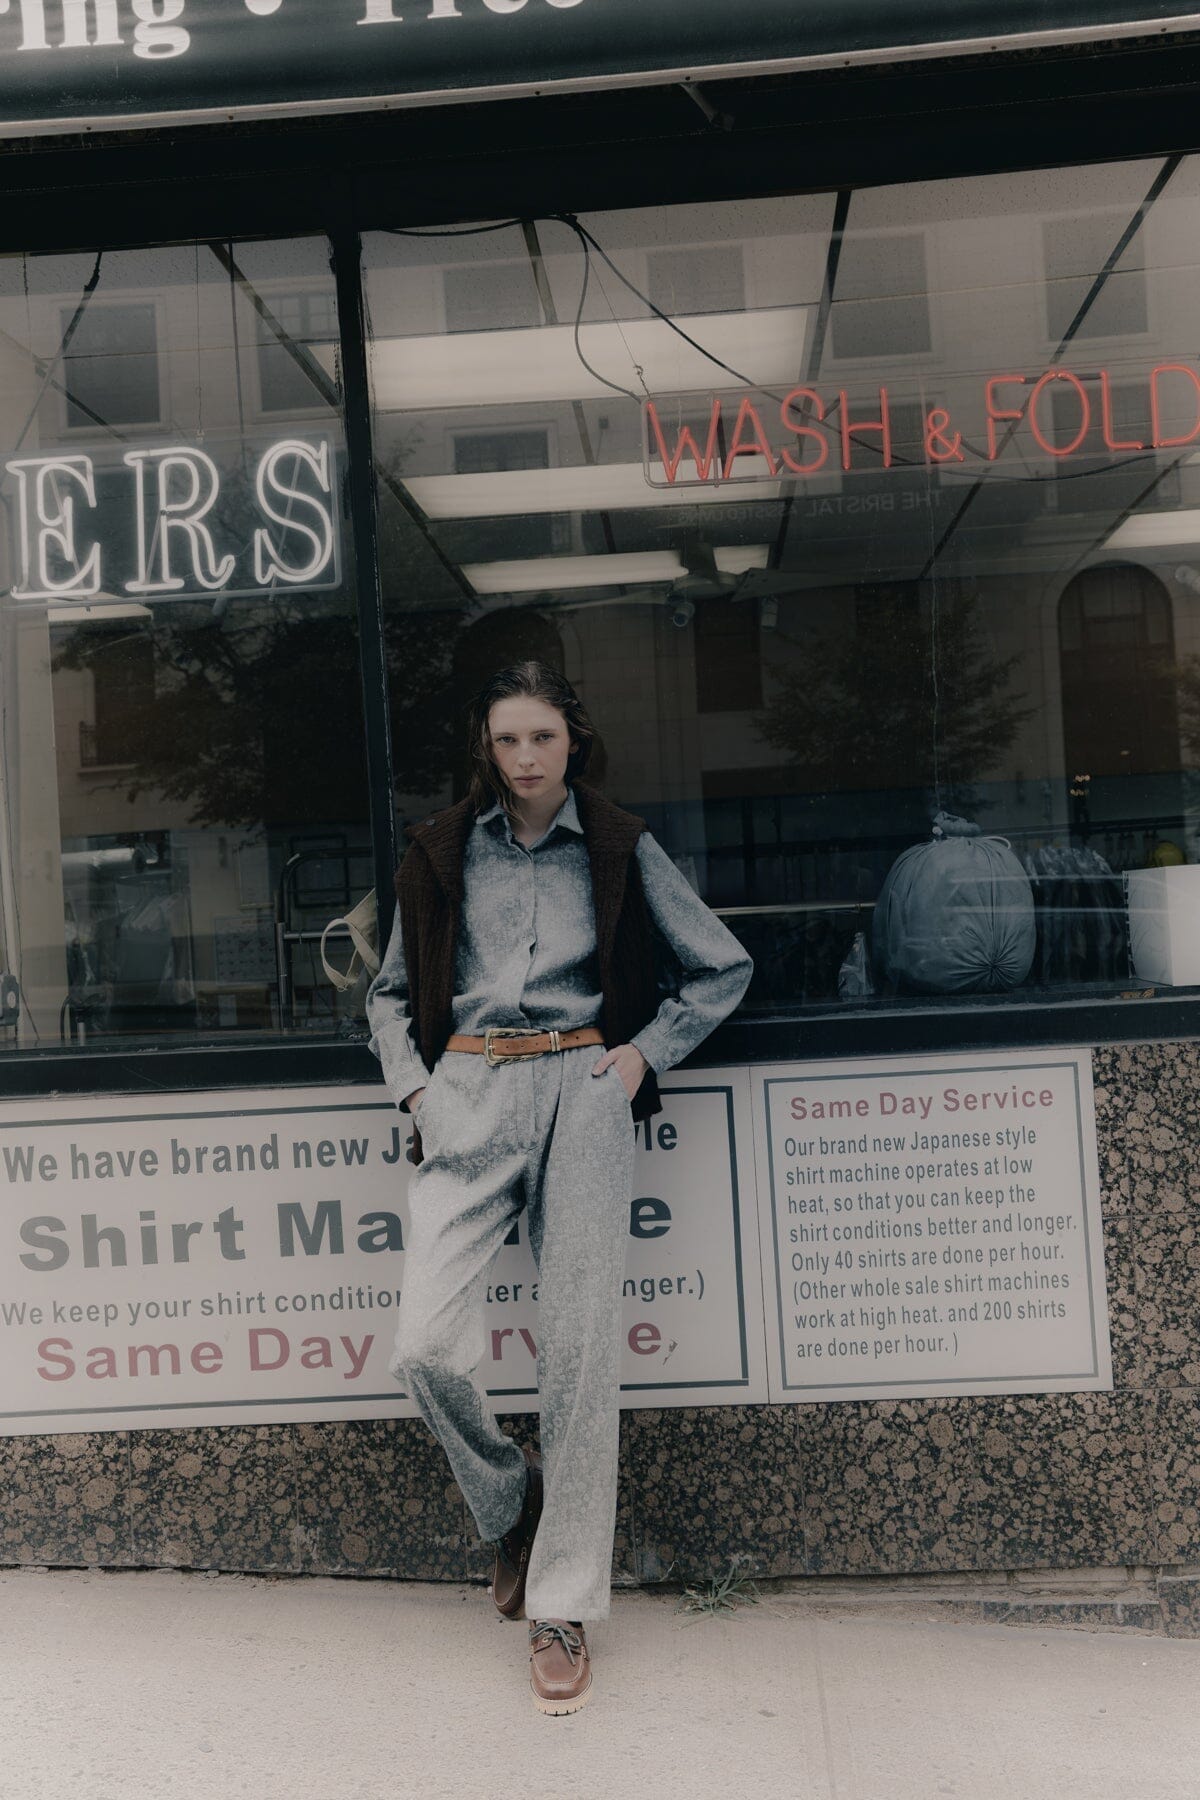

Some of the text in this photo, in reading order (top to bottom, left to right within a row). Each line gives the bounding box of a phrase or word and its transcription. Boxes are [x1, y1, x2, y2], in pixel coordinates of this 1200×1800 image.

[647, 365, 1200, 484] WASH & FOLD
[5, 440, 333, 599] ERS
[791, 1086, 1053, 1120] Same Day Service
[2, 1146, 58, 1183] We
[71, 1144, 158, 1179] have
[171, 1133, 279, 1174] brand
[293, 1139, 369, 1168] new
[785, 1126, 1036, 1156] Our brand new Japanese style
[786, 1156, 1032, 1185] shirt machine operates at low
[788, 1184, 1035, 1216] heat, so that you can keep the
[19, 1206, 246, 1271] Shirt
[790, 1213, 1076, 1243] shirt conditions better and longer.
[792, 1252, 829, 1275] Only
[835, 1250, 852, 1269] 40
[912, 1251, 937, 1266] are
[943, 1245, 983, 1264] done
[989, 1247, 1015, 1267] per
[1021, 1242, 1063, 1261] hour.
[1, 1302, 43, 1326] We
[53, 1301, 118, 1327] keep
[128, 1300, 191, 1326] your
[201, 1291, 266, 1316] shirt
[622, 1269, 705, 1302] nger.)
[794, 1270, 1069, 1305] (Other whole sale shirt machines
[795, 1299, 1065, 1330] work at high heat. and 200 shirts
[37, 1328, 375, 1381] Same Day
[798, 1343, 822, 1357] are
[828, 1338, 868, 1356] done
[874, 1339, 900, 1359] per
